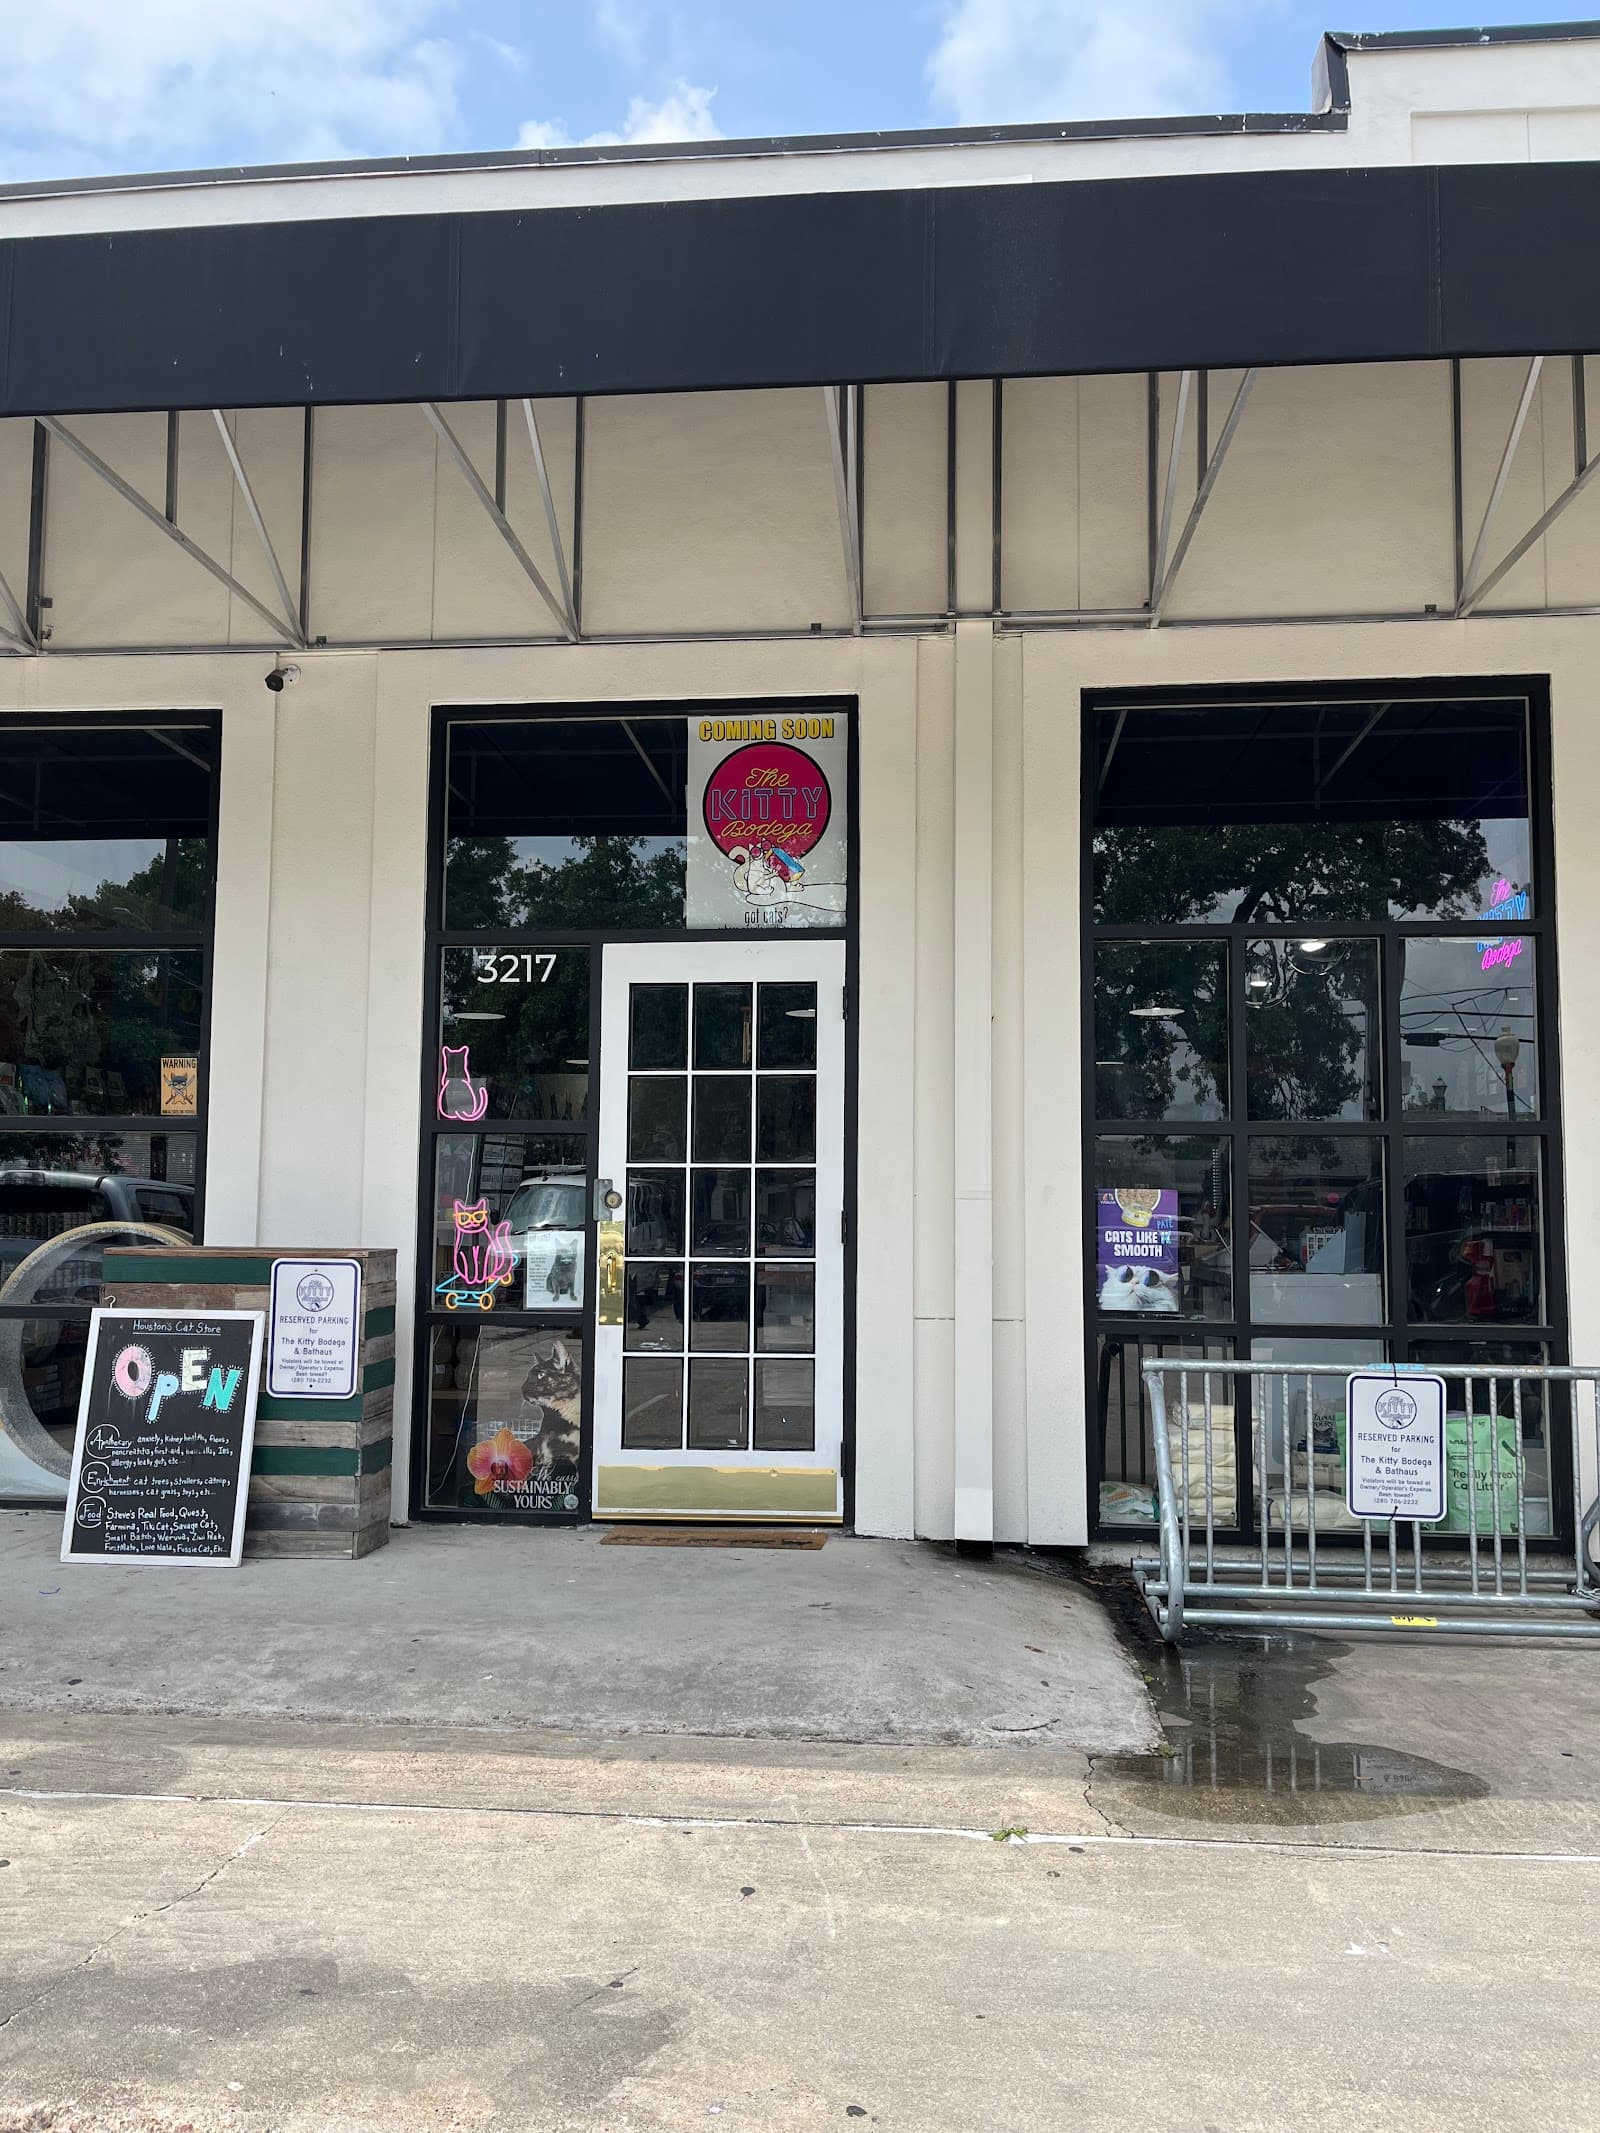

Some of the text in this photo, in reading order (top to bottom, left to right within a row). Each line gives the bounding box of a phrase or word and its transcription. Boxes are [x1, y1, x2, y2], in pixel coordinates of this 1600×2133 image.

[700, 718, 834, 741] COMING SOON
[745, 768, 789, 788] The
[711, 787, 822, 820] KITTY
[721, 820, 813, 842] Bodega
[745, 907, 788, 926] got cats?
[477, 954, 556, 983] 3217
[162, 1059, 196, 1068] WARNING
[1105, 1231, 1133, 1243] CATS
[1136, 1231, 1158, 1243] LIKE
[1114, 1244, 1162, 1257] SMOOTH
[133, 1320, 222, 1333] Houston's Cat Store
[280, 1316, 349, 1325] RESERVED PARKING
[298, 1338, 315, 1346] Kitty
[318, 1338, 345, 1347] Bodega
[1358, 1433, 1434, 1443] RESERVED PARKING
[1379, 1456, 1398, 1466] Kitty
[1402, 1457, 1432, 1468] Bodega
[1385, 1467, 1418, 1475] Bathaus
[1453, 1469, 1487, 1481] Relly
[134, 1475, 148, 1485] cat
[1453, 1481, 1468, 1489] Ca
[494, 1480, 572, 1494] SUSTAINABLY
[514, 1494, 552, 1509] YOURS
[79, 1504, 208, 1520] Food Steve's Real Food, Quest,
[105, 1521, 140, 1533] Farmina,
[173, 1522, 198, 1534] Savage
[200, 1520, 218, 1532] Cat,
[104, 1532, 126, 1542] Small
[130, 1532, 156, 1542] Batch,
[141, 1543, 156, 1551] Love
